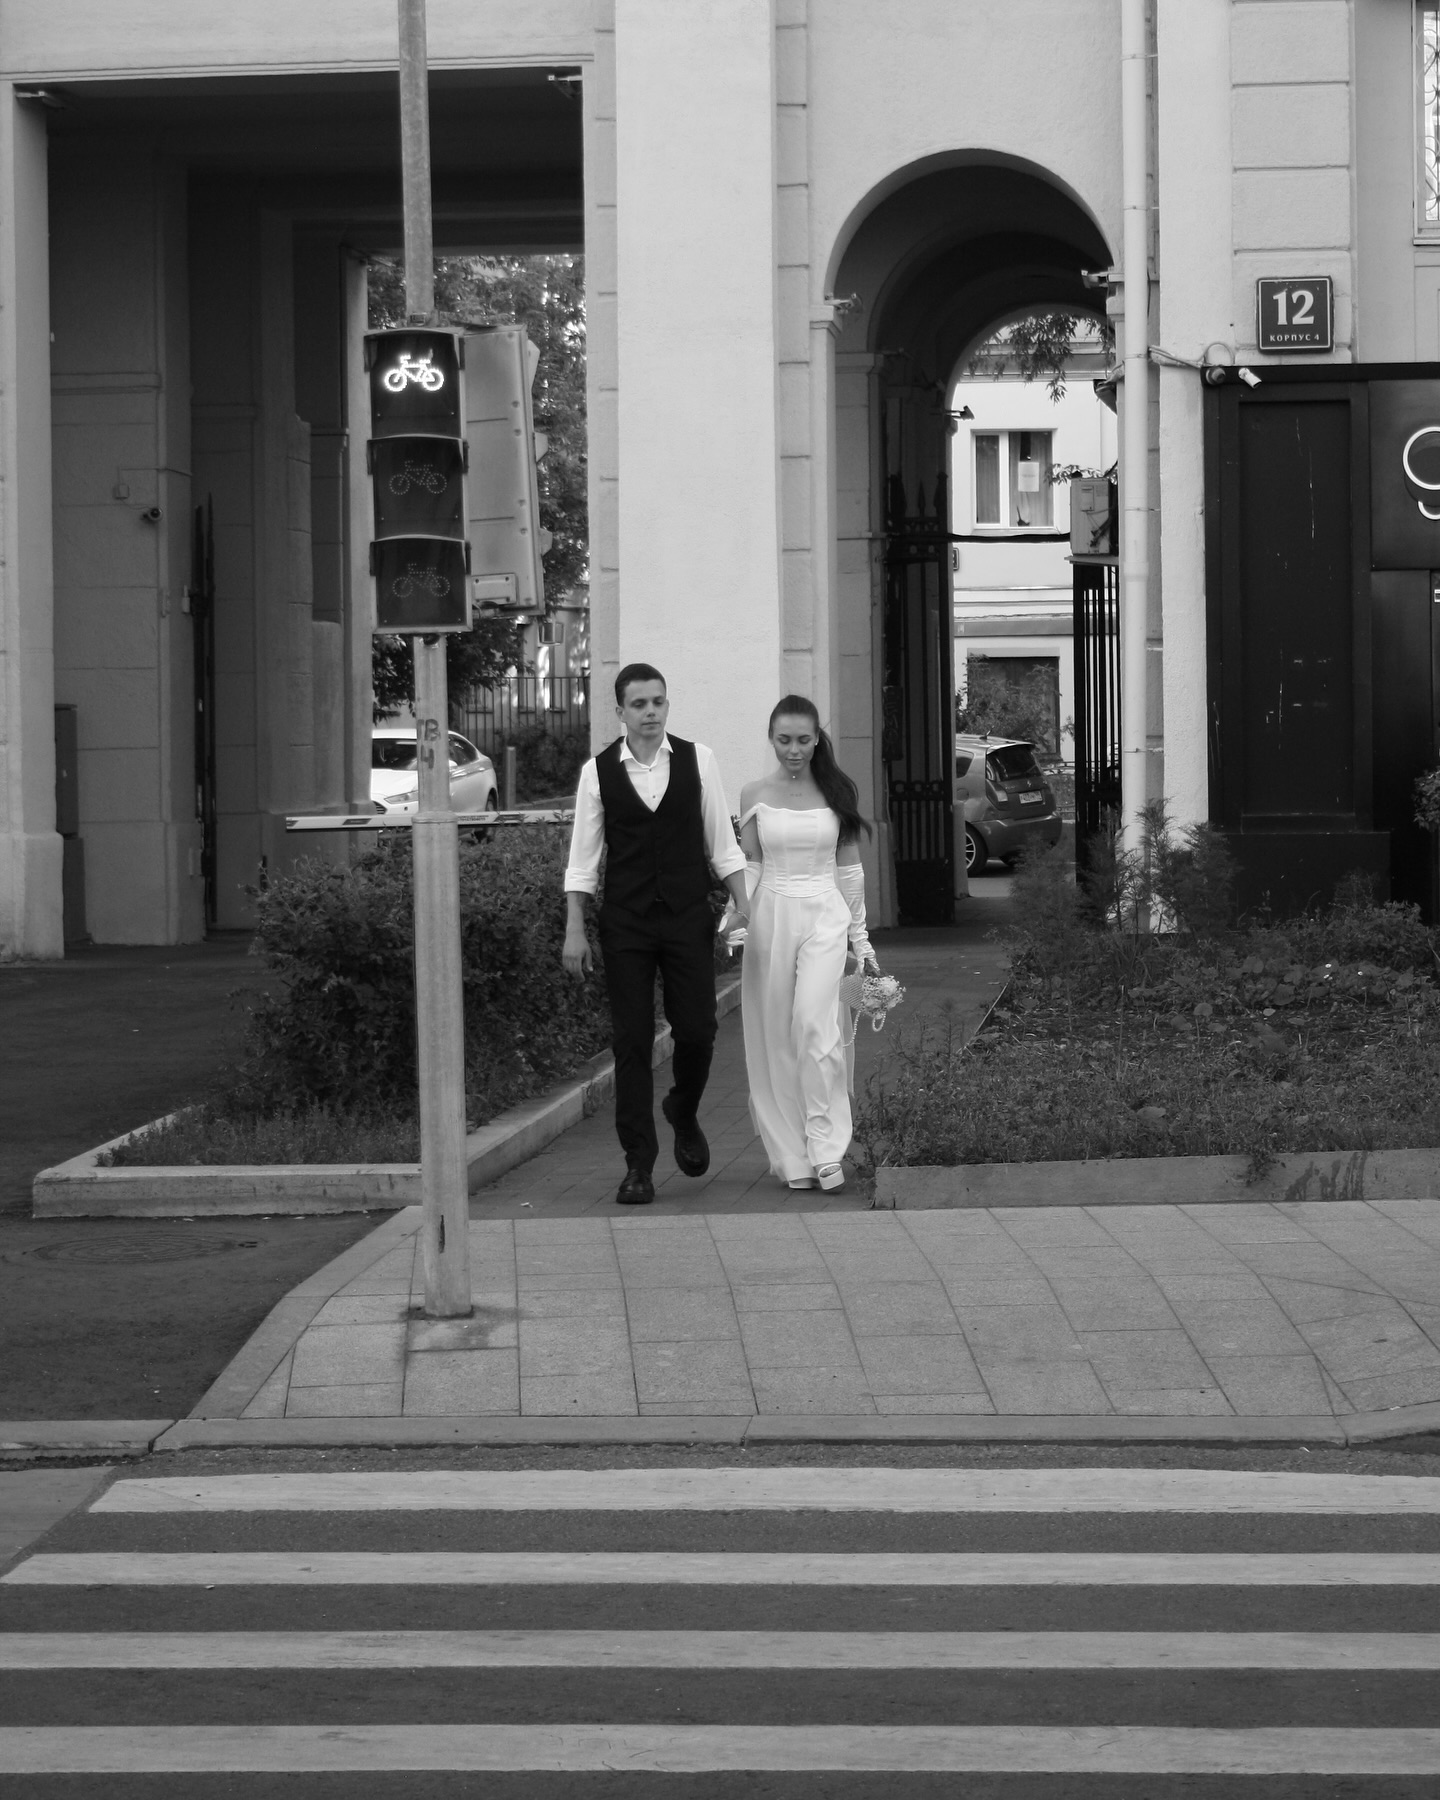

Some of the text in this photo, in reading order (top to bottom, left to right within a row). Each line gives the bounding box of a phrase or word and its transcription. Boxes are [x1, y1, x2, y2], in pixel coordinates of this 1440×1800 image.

[1273, 288, 1315, 325] 12
[1269, 333, 1320, 342] КОРПУС 4
